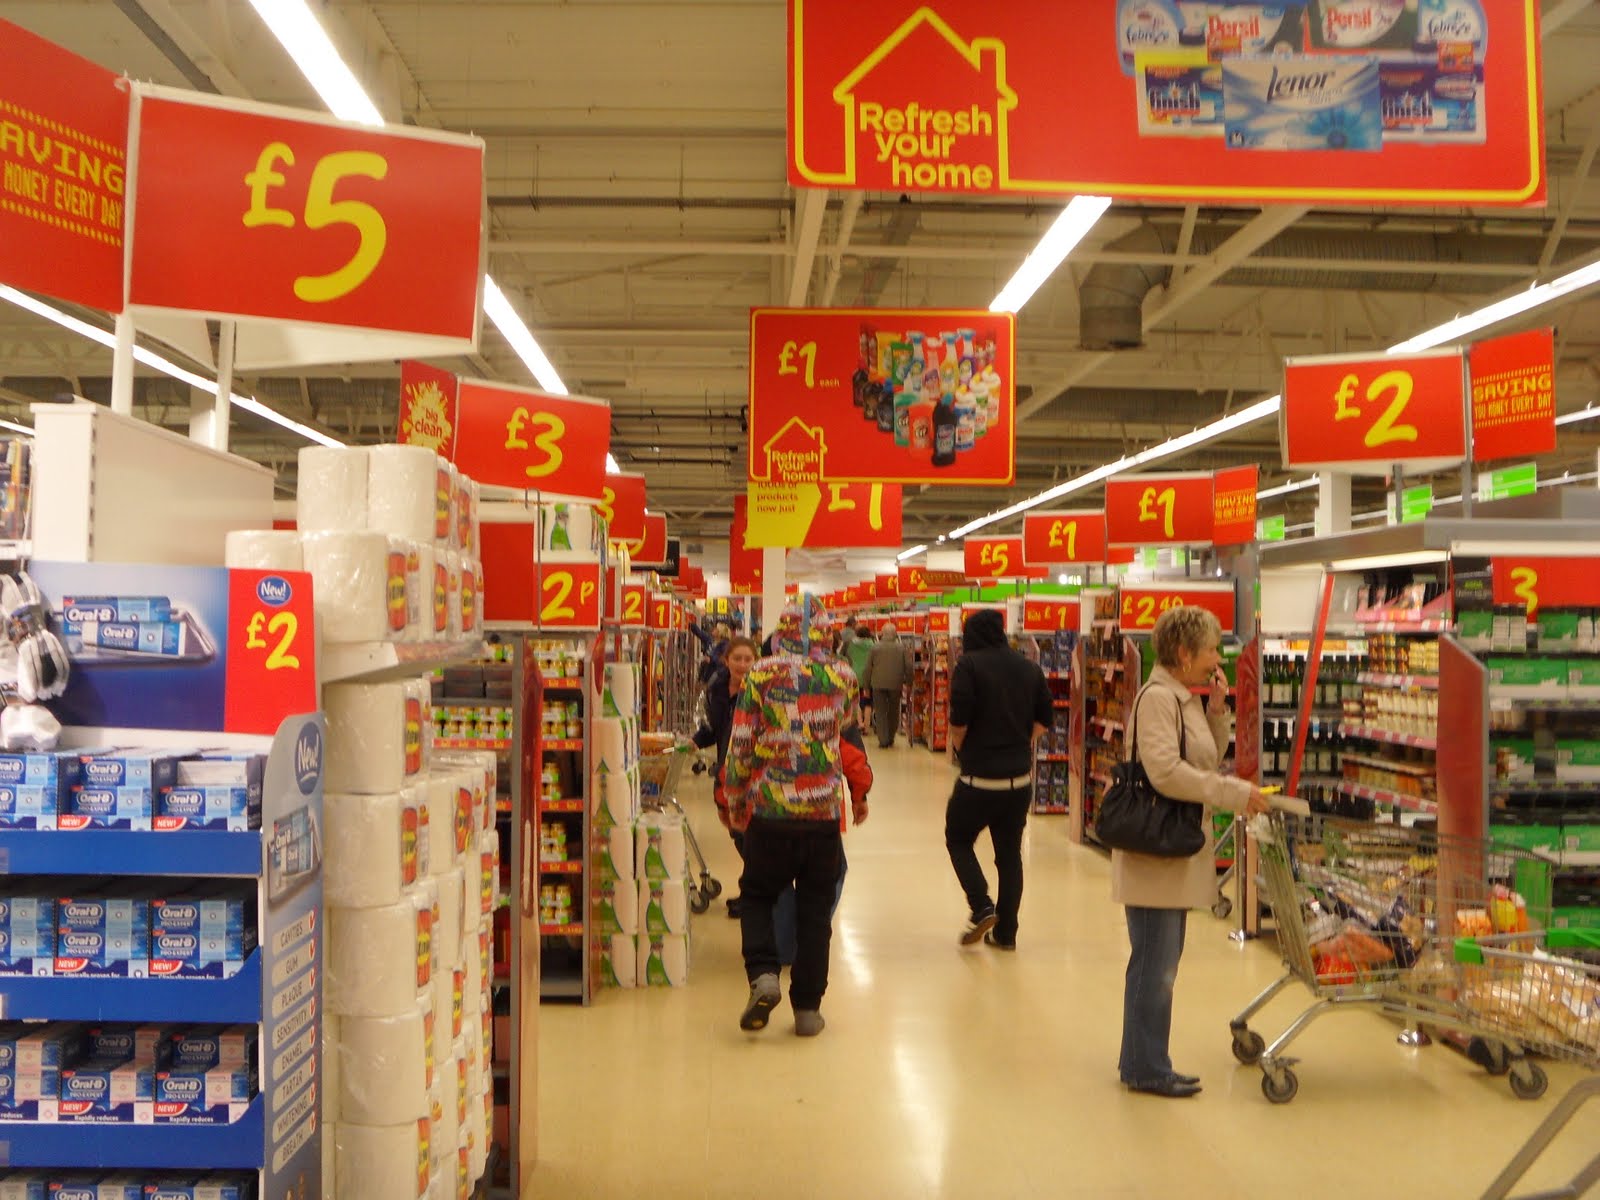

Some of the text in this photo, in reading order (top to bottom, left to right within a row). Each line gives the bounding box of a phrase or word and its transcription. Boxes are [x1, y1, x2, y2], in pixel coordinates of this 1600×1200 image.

[859, 102, 992, 136] Refresh
[875, 132, 955, 162] your
[0, 120, 124, 196] AVING
[892, 155, 993, 189] home
[4, 160, 122, 230] MONEY EVERY DAY
[243, 142, 388, 302] £5
[778, 340, 840, 388] £1 each
[1474, 373, 1552, 403] SAVING
[425, 407, 438, 422] big
[1334, 370, 1418, 448] £2
[414, 421, 443, 439] clean
[505, 406, 565, 477] £3
[772, 449, 819, 463] Refresh
[783, 470, 819, 482] home
[757, 491, 798, 502] products
[757, 503, 796, 514] now just
[1139, 487, 1175, 538] £1
[1049, 520, 1077, 560] £1
[980, 543, 1008, 576] £5
[259, 580, 287, 599] New!
[68, 608, 111, 621] Oral-B
[103, 627, 134, 639] Oral-B
[246, 611, 299, 669] £2
[297, 733, 319, 773] New!
[89, 764, 119, 773] Oral-B
[80, 793, 110, 802] Oral-B
[169, 795, 198, 804] Oral-B
[61, 818, 81, 826] NEW!
[68, 906, 99, 916] Oral-B
[162, 908, 192, 917] Oral-B
[67, 936, 97, 945] Oral-B
[280, 921, 303, 948] CAVITIES
[161, 938, 192, 947] Oral-B
[59, 960, 77, 968] NEW!
[153, 962, 172, 970] NEW!
[285, 955, 298, 975] GUM
[281, 981, 303, 1009] PLAQUE
[182, 1044, 212, 1052] Oral-B
[71, 1080, 103, 1089] Oral-B
[166, 1081, 197, 1090] Oral-B
[63, 1103, 82, 1111] NEW!
